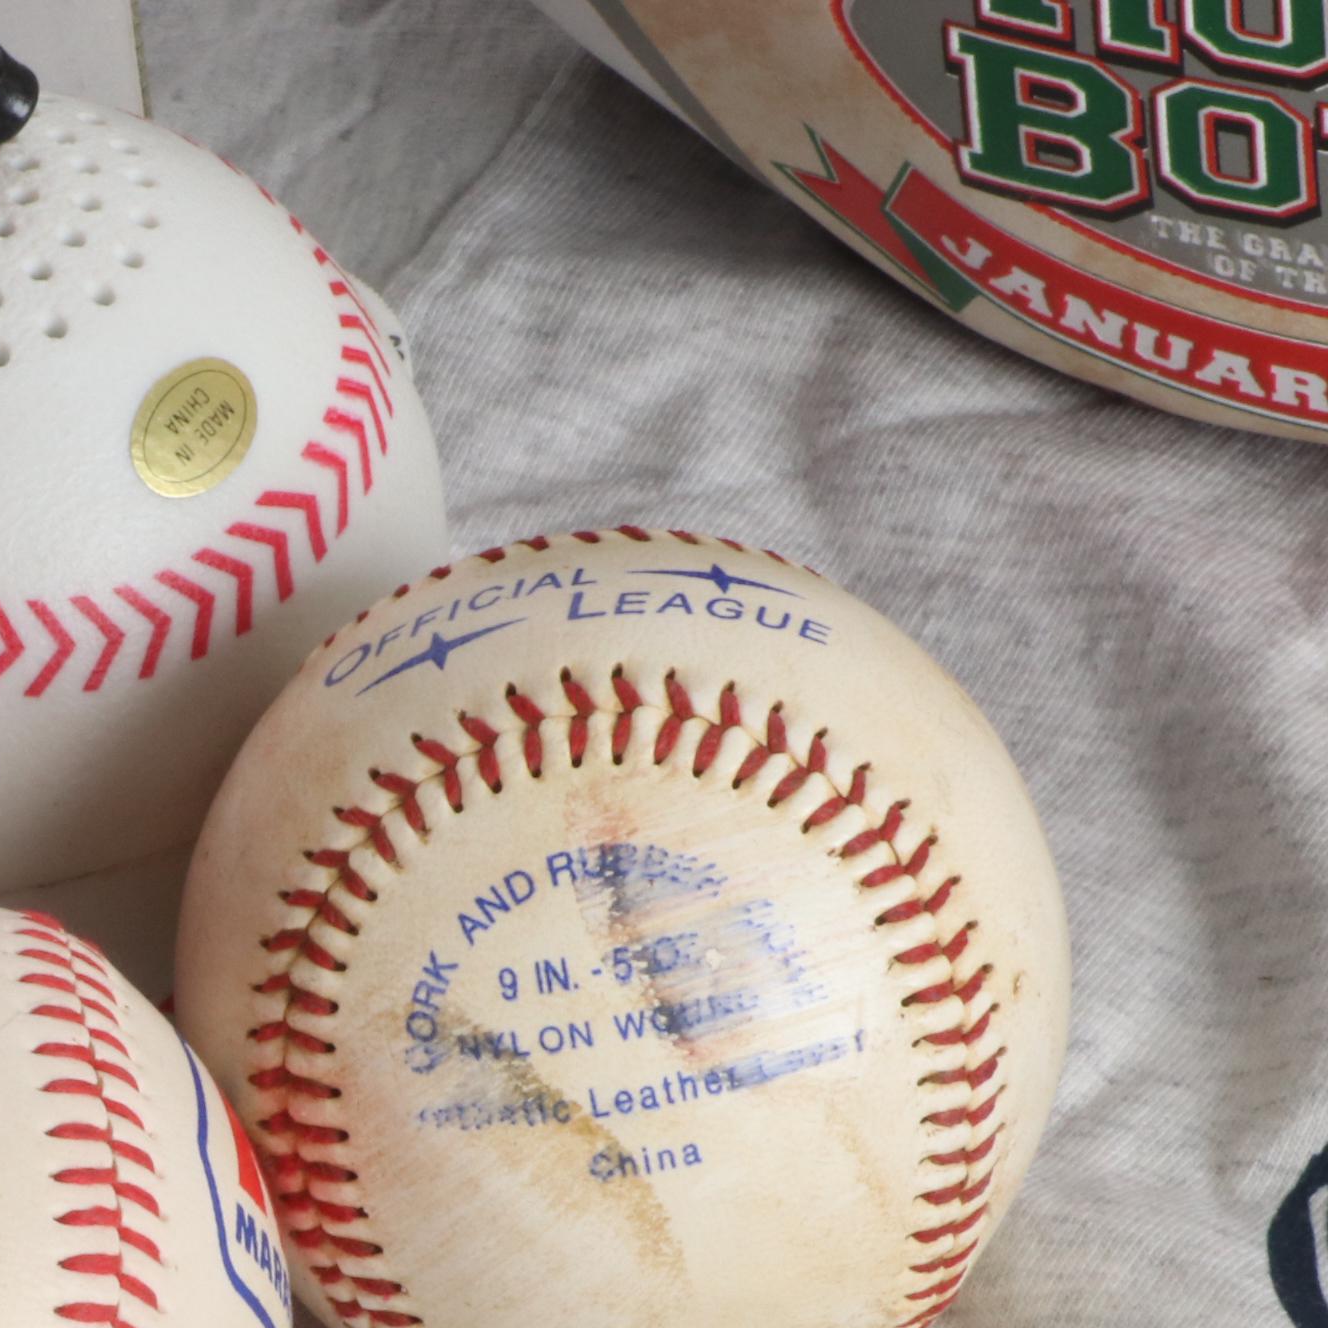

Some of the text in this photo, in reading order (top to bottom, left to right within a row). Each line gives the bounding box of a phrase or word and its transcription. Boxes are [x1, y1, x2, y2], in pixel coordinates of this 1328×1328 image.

[944, 20, 1328, 224] BO
[1150, 214, 1228, 251] THE
[1213, 253, 1258, 283] OF
[163, 386, 211, 435] CHINA
[174, 399, 235, 467] MADE IN
[323, 567, 834, 688] OFFICIAL LEAGUE
[404, 949, 459, 1074] CORK
[455, 869, 537, 945] AND
[497, 966, 519, 1001] 9
[457, 1020, 594, 1061] NYLON
[588, 1065, 742, 1119] Leather
[589, 1142, 703, 1181] China
